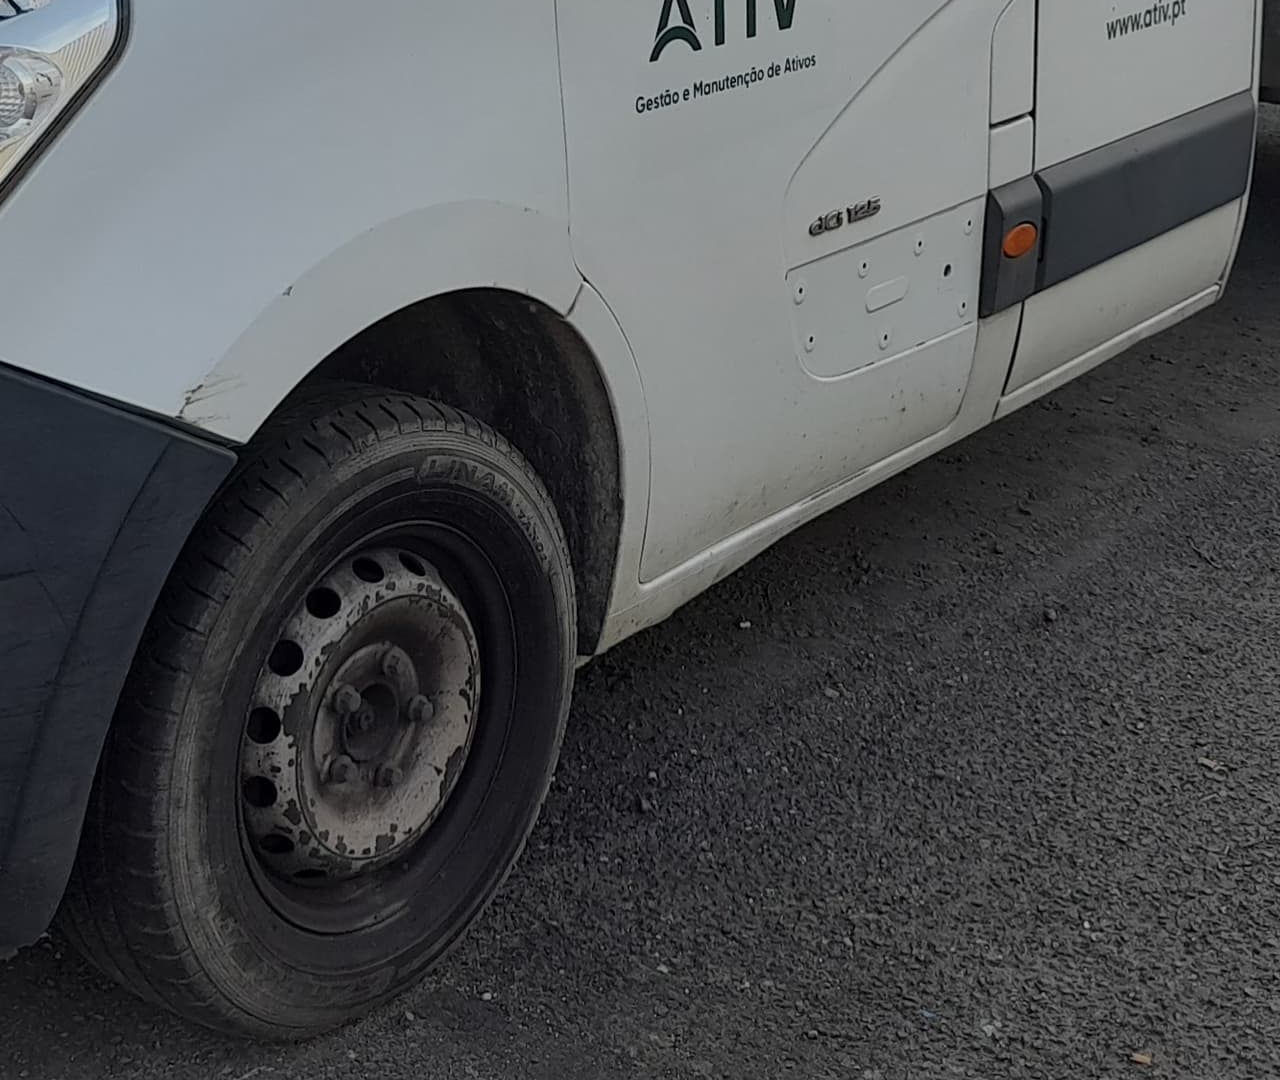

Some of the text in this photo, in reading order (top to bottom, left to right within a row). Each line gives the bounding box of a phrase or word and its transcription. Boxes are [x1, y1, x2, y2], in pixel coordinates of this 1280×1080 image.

[635, 54, 817, 114] Gestão e Manutenção de Ativos
